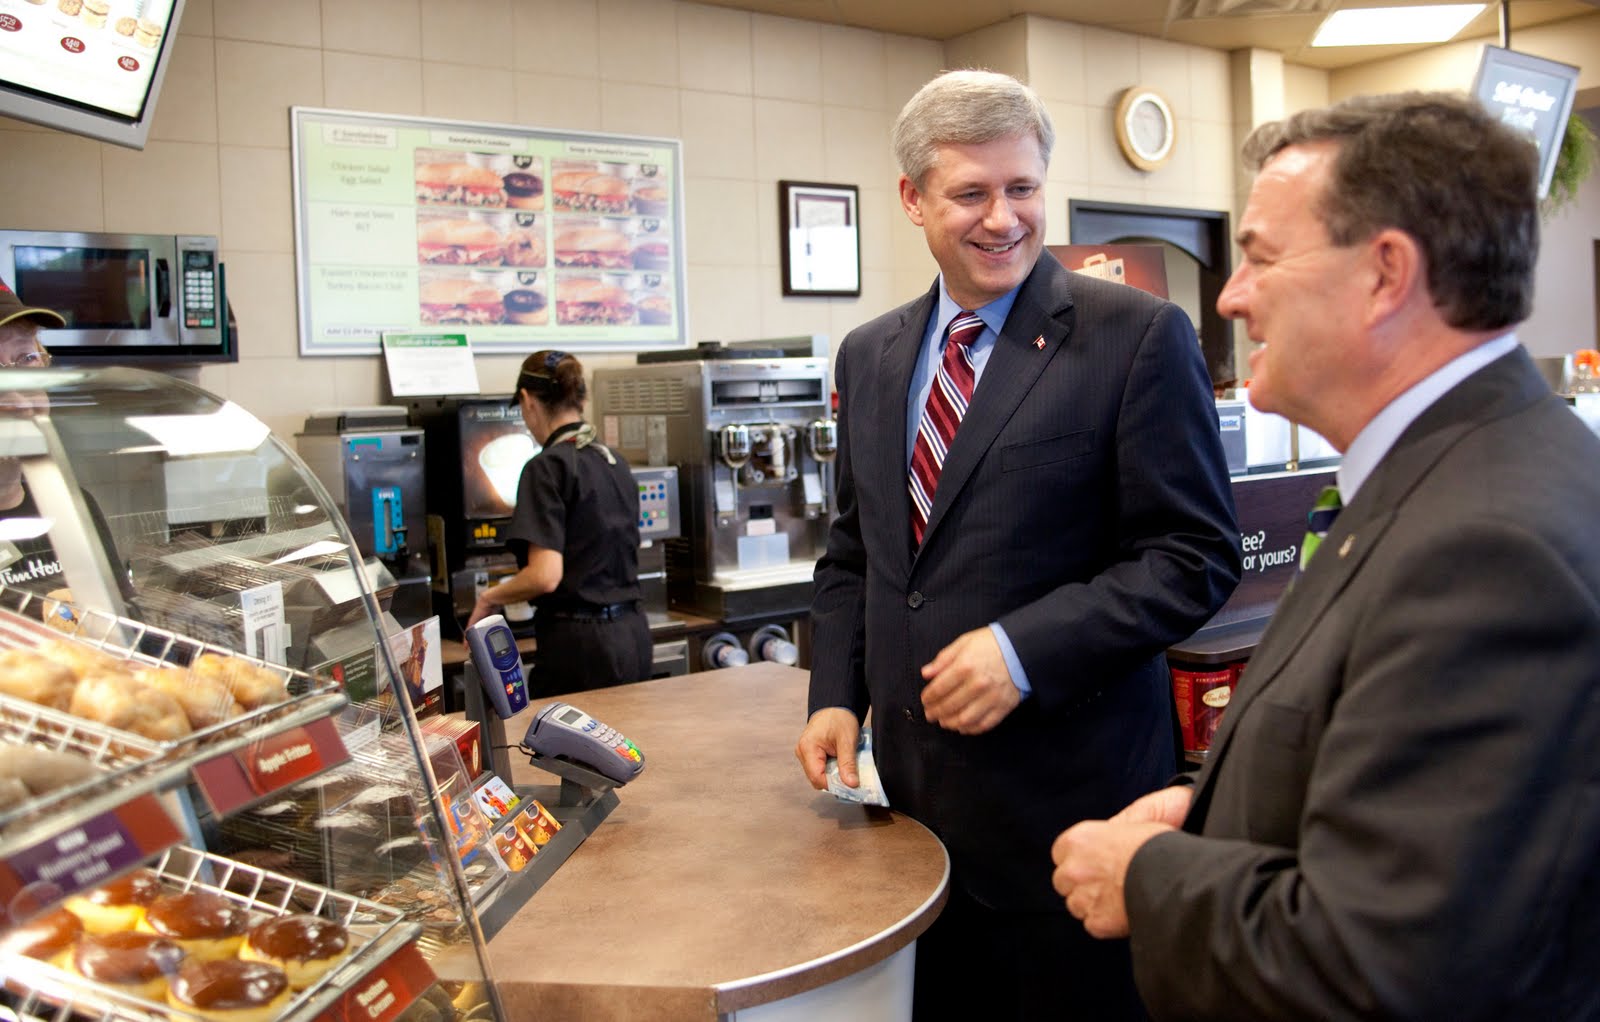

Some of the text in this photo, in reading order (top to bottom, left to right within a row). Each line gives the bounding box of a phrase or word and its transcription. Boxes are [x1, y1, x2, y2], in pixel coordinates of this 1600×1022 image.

[1241, 530, 1266, 552] ee?
[1243, 545, 1297, 573] or yours?
[258, 753, 288, 774] Apple
[356, 977, 389, 1007] Boston
[368, 992, 396, 1018] Cream
